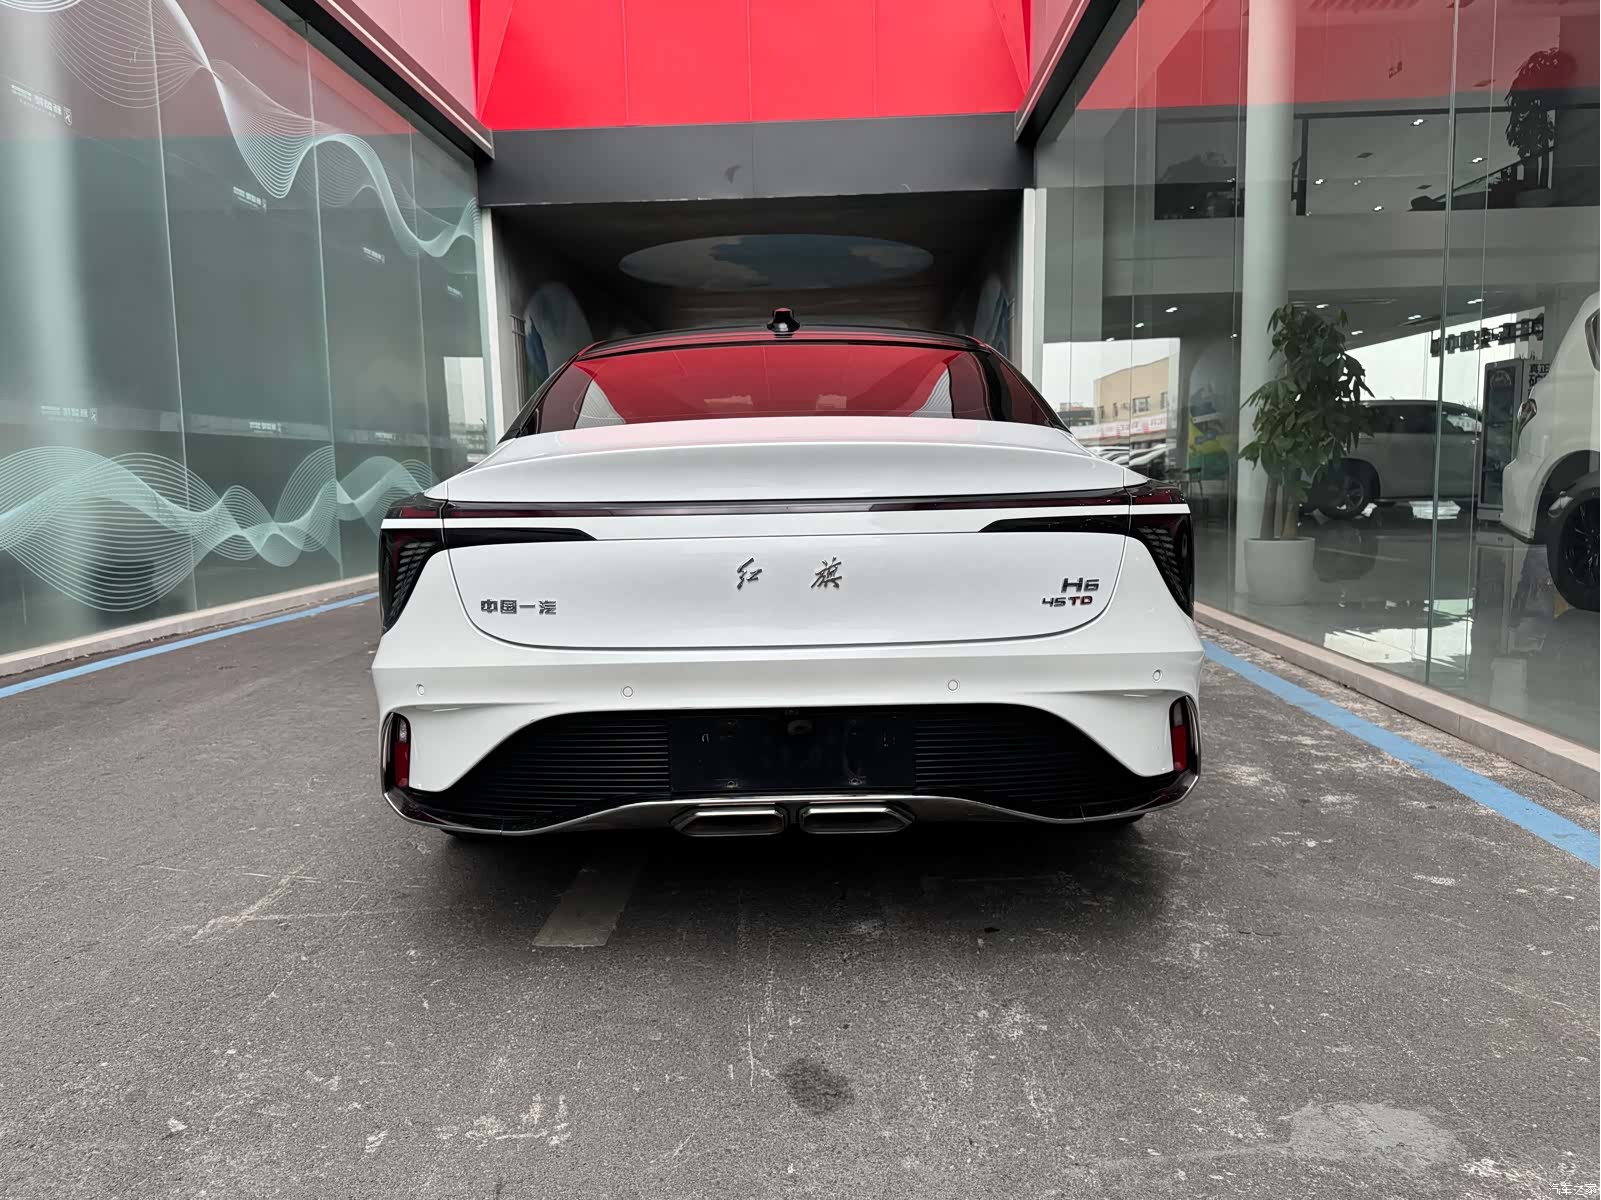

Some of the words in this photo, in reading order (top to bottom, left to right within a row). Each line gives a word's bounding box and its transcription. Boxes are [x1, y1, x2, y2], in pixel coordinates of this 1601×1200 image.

[736, 556, 843, 590] 红旗
[1061, 577, 1100, 593] H6
[480, 599, 557, 615] 中国一汽
[1041, 595, 1093, 608] 45TD
